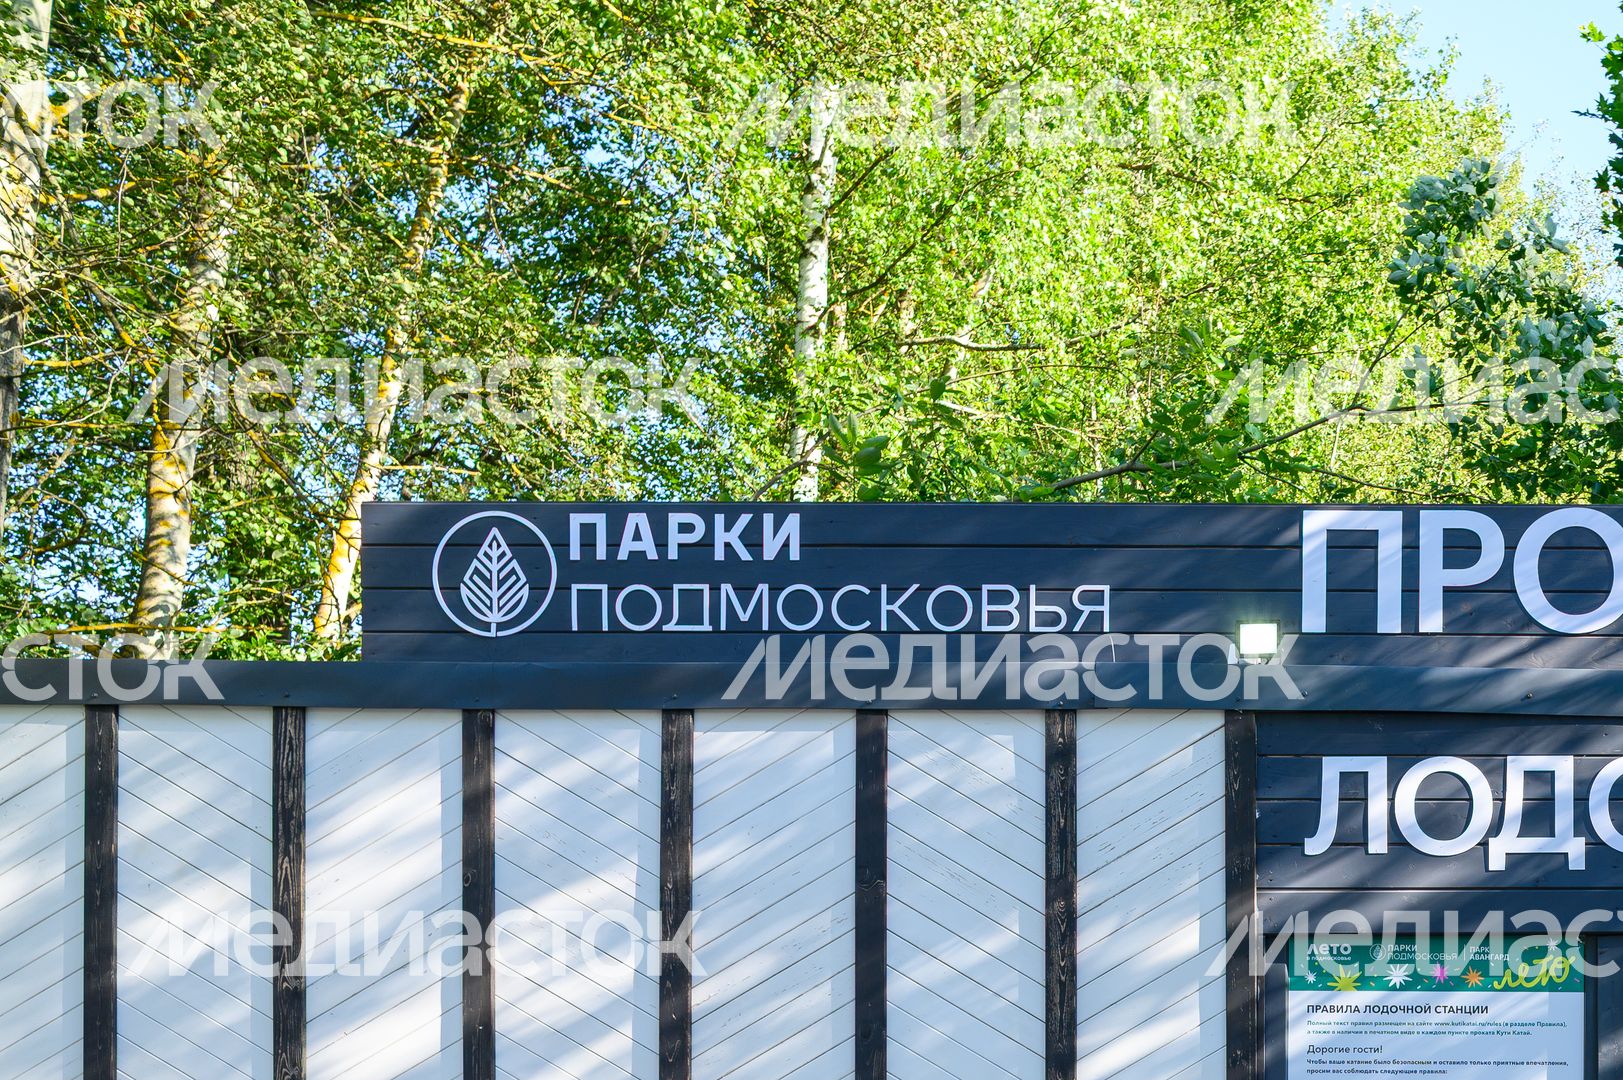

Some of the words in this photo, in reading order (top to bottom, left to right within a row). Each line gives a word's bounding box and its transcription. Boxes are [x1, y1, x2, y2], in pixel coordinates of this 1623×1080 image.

[568, 513, 801, 562] ПАРКИ
[570, 583, 1111, 632] ПОДМОСКОВЬЯ
[1387, 943, 1418, 952] ПАРКИ
[1387, 952, 1458, 961] ПОДМОСКОВЬЯ
[1469, 953, 1510, 962] АВАНГАРД
[1306, 1004, 1361, 1014] ПРАВИЛА
[1363, 1002, 1432, 1015] ЛОДОЧНОЙ
[1434, 1005, 1489, 1015] СТАНЦИИ
[1306, 1044, 1350, 1055] Дорогие
[1352, 1045, 1383, 1054] гости!
[1328, 1058, 1346, 1066] ваше
[1346, 1058, 1372, 1066] катание
[1306, 1068, 1331, 1076] просим
[1343, 1068, 1379, 1076] соблюдать
[1380, 1068, 1418, 1076] следующие
[1418, 1068, 1448, 1076] правила:
